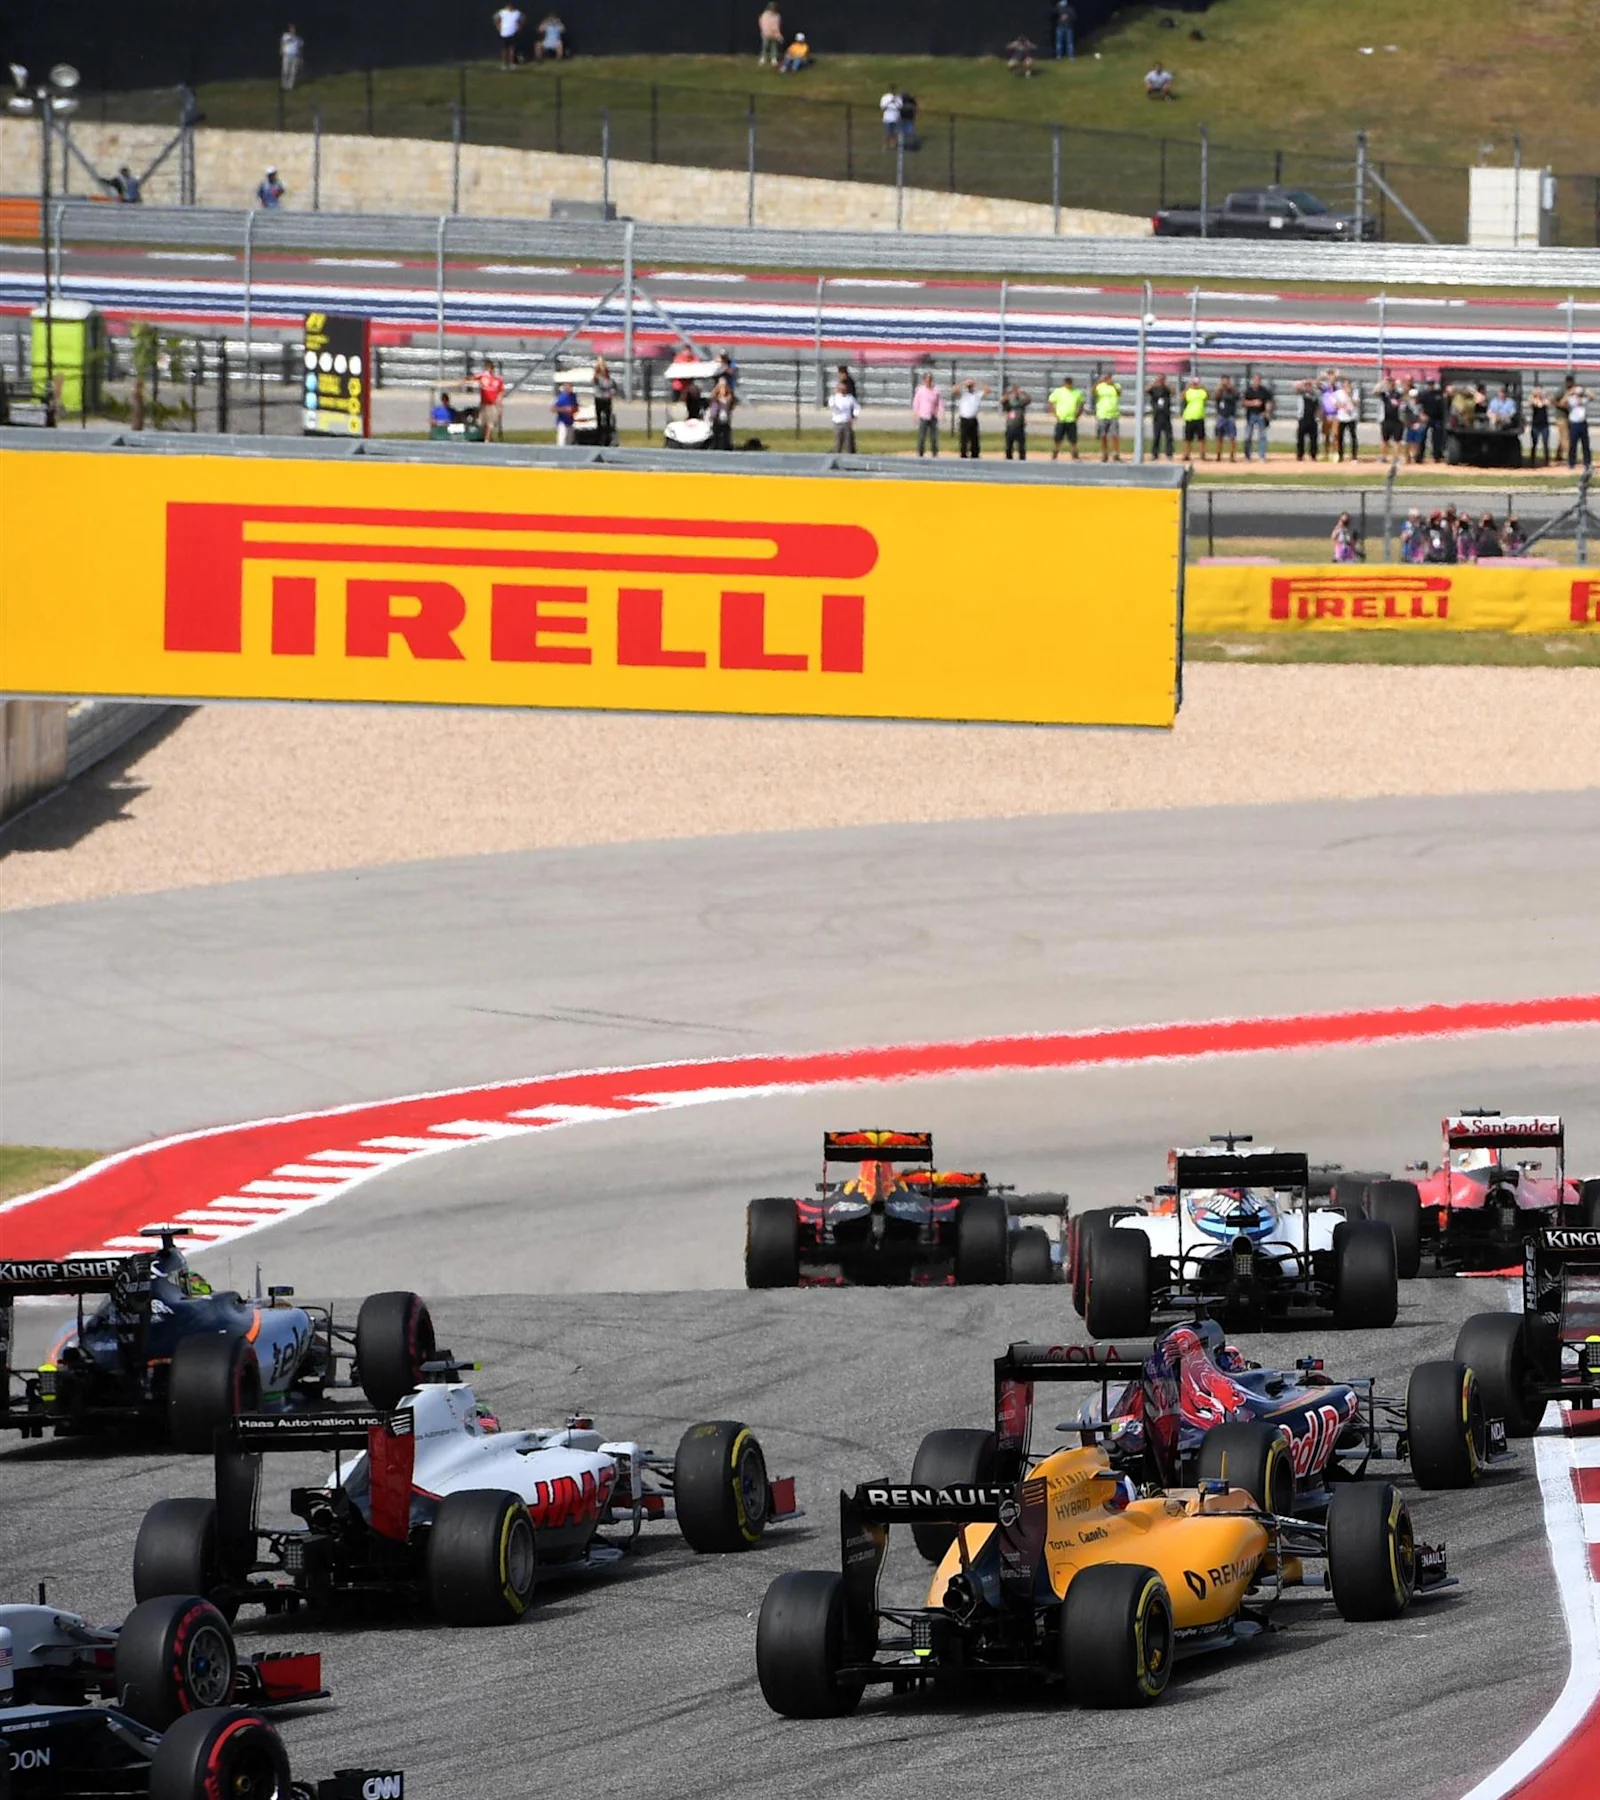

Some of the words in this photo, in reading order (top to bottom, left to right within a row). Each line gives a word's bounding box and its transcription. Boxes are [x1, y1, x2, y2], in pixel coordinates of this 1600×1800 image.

[164, 502, 878, 673] PIRELLI
[1270, 577, 1452, 620] PIRELLI
[1472, 1120, 1557, 1134] Santander
[1047, 1345, 1121, 1364] COLA
[239, 1419, 274, 1428] Haas
[278, 1416, 354, 1427] Automation
[359, 1416, 383, 1425] Inc.
[1047, 1470, 1089, 1490] NFINITI
[1055, 1498, 1091, 1520] HYBRID
[1048, 1540, 1075, 1550] TOTAL
[1421, 1551, 1445, 1568] ENAULT
[1207, 1552, 1263, 1588] RENAULT
[362, 1775, 401, 1800] CNN
